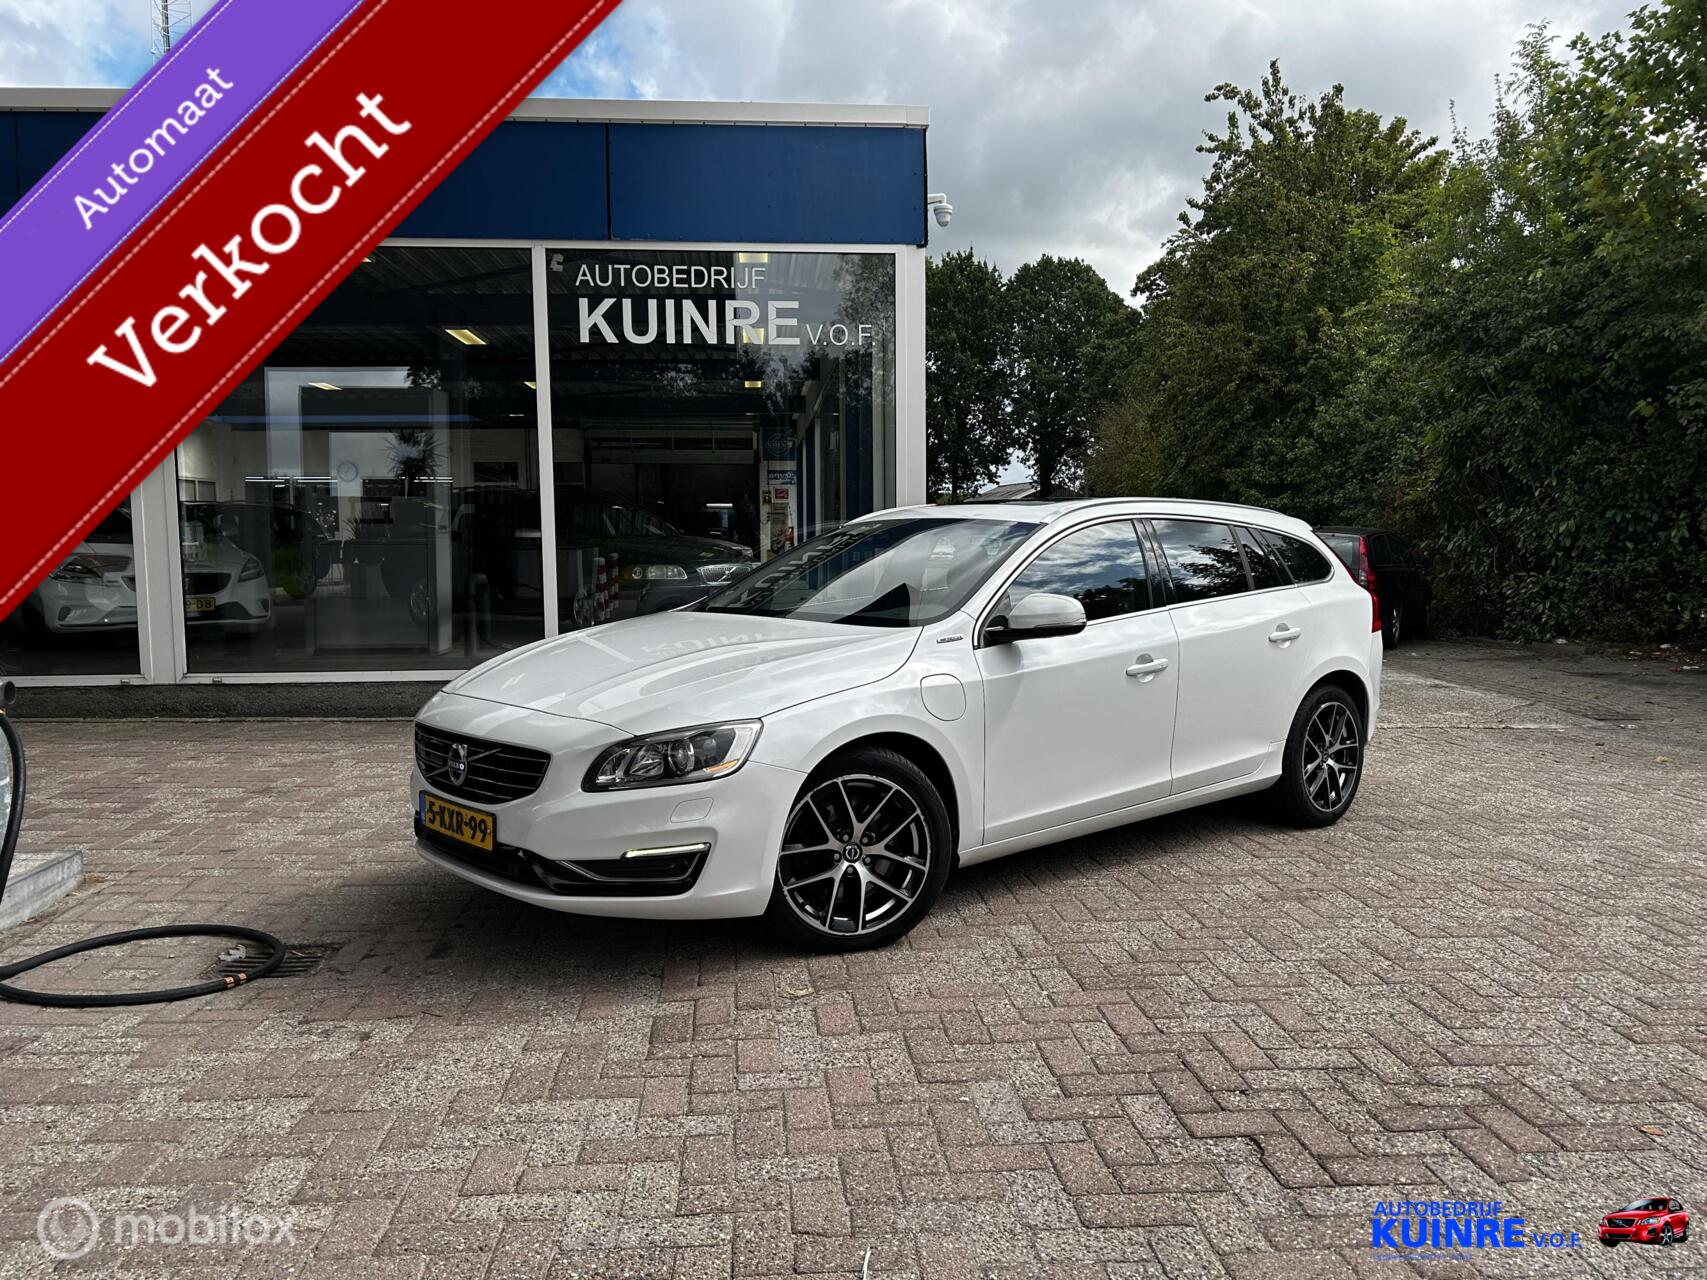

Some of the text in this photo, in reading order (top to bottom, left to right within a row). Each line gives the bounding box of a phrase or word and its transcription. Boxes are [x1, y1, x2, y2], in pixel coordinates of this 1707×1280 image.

[575, 264, 766, 289] AUTOBEDRIJF
[578, 297, 876, 346] KUINRE V.O.F.
[428, 801, 488, 843] 5-KXR-99
